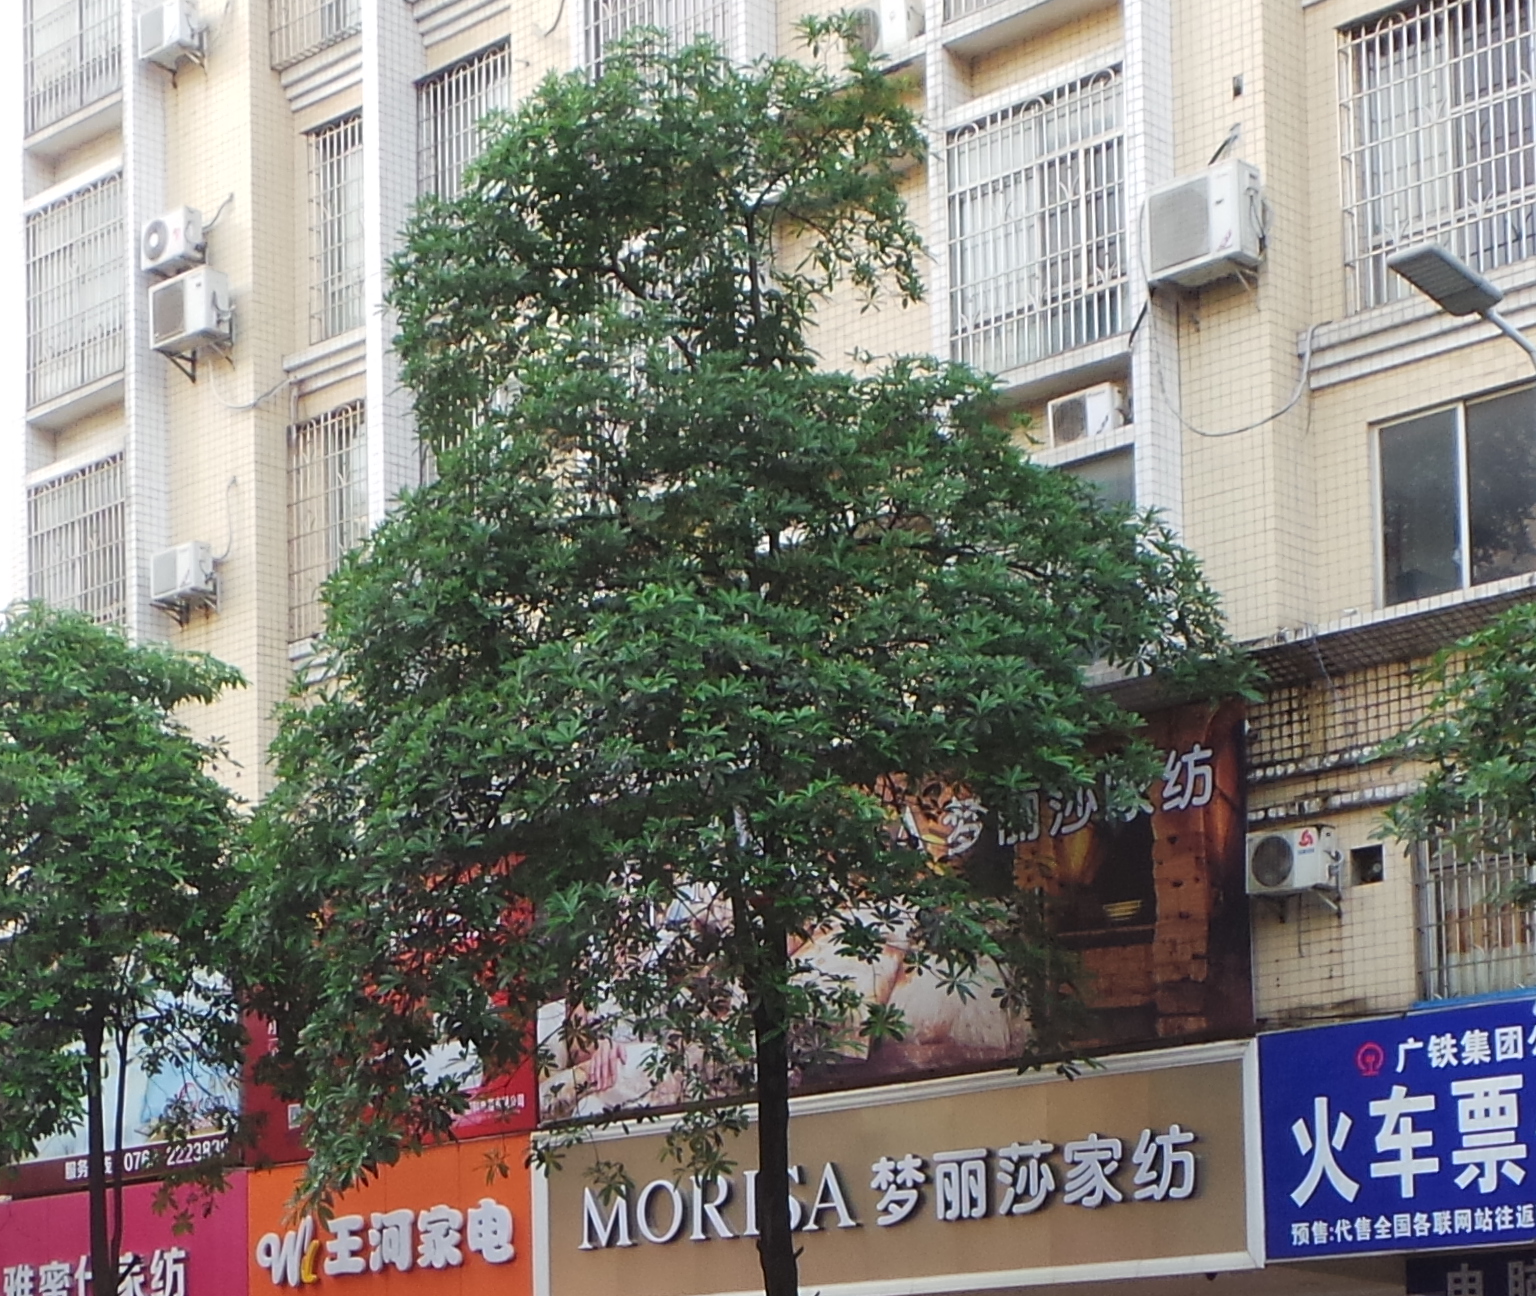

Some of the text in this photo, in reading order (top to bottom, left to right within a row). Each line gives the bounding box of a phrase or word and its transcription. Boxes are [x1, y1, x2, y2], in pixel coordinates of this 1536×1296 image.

[869, 1123, 1198, 1228] 梦丽莎家纺
[325, 1196, 515, 1277] 王河家电
